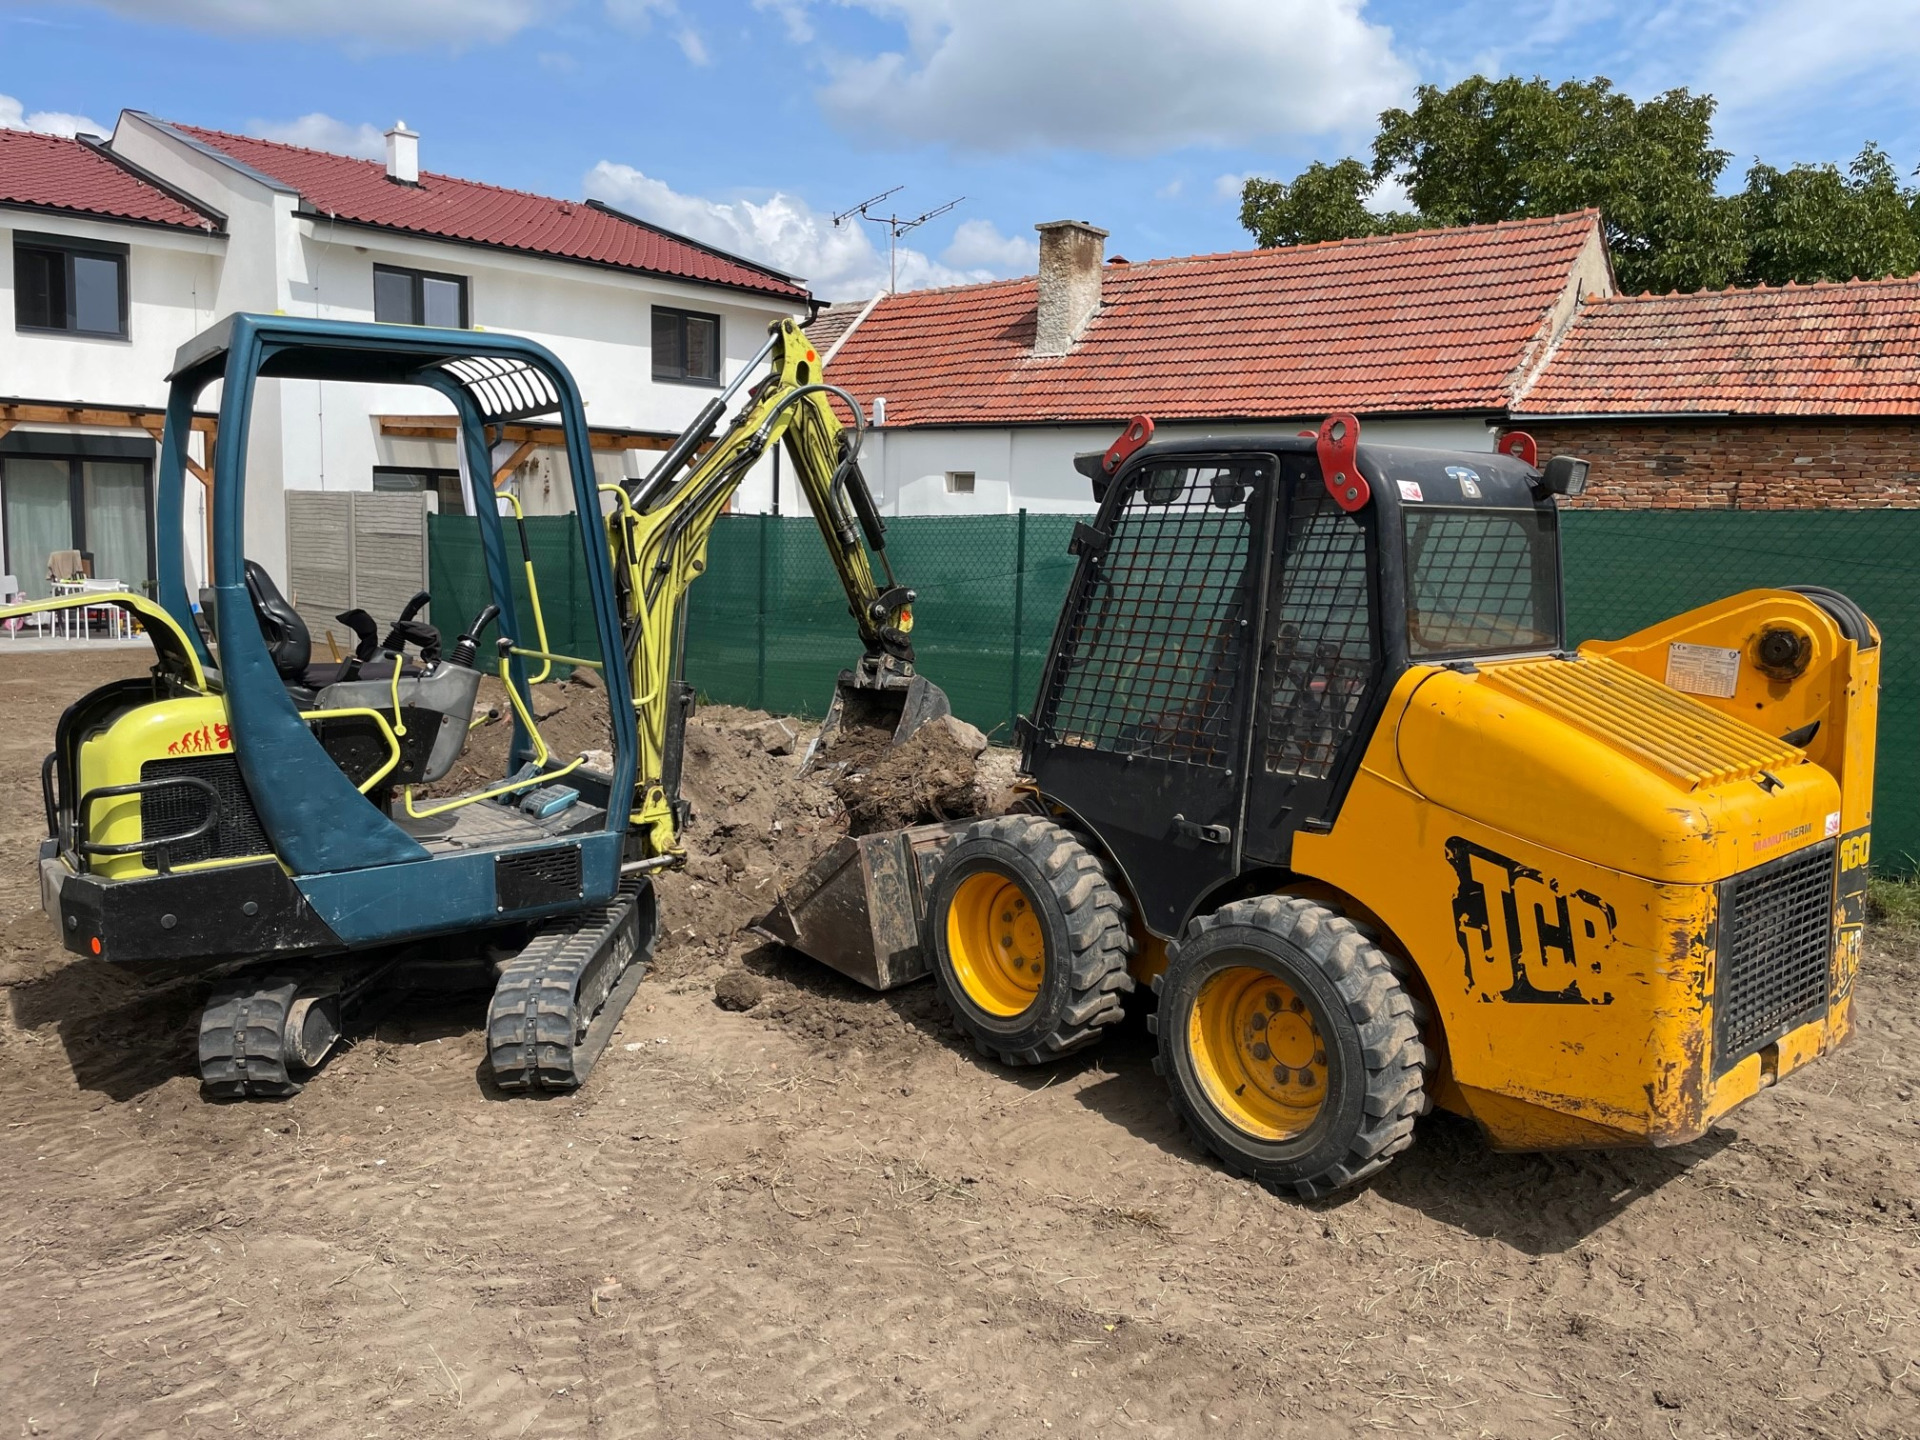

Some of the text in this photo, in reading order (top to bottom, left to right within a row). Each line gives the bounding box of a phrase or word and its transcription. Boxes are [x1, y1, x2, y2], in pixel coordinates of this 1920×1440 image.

[1753, 823, 1812, 852] MAMUTHERM
[1840, 832, 1871, 873] 160
[1460, 850, 1616, 1002] JCB
